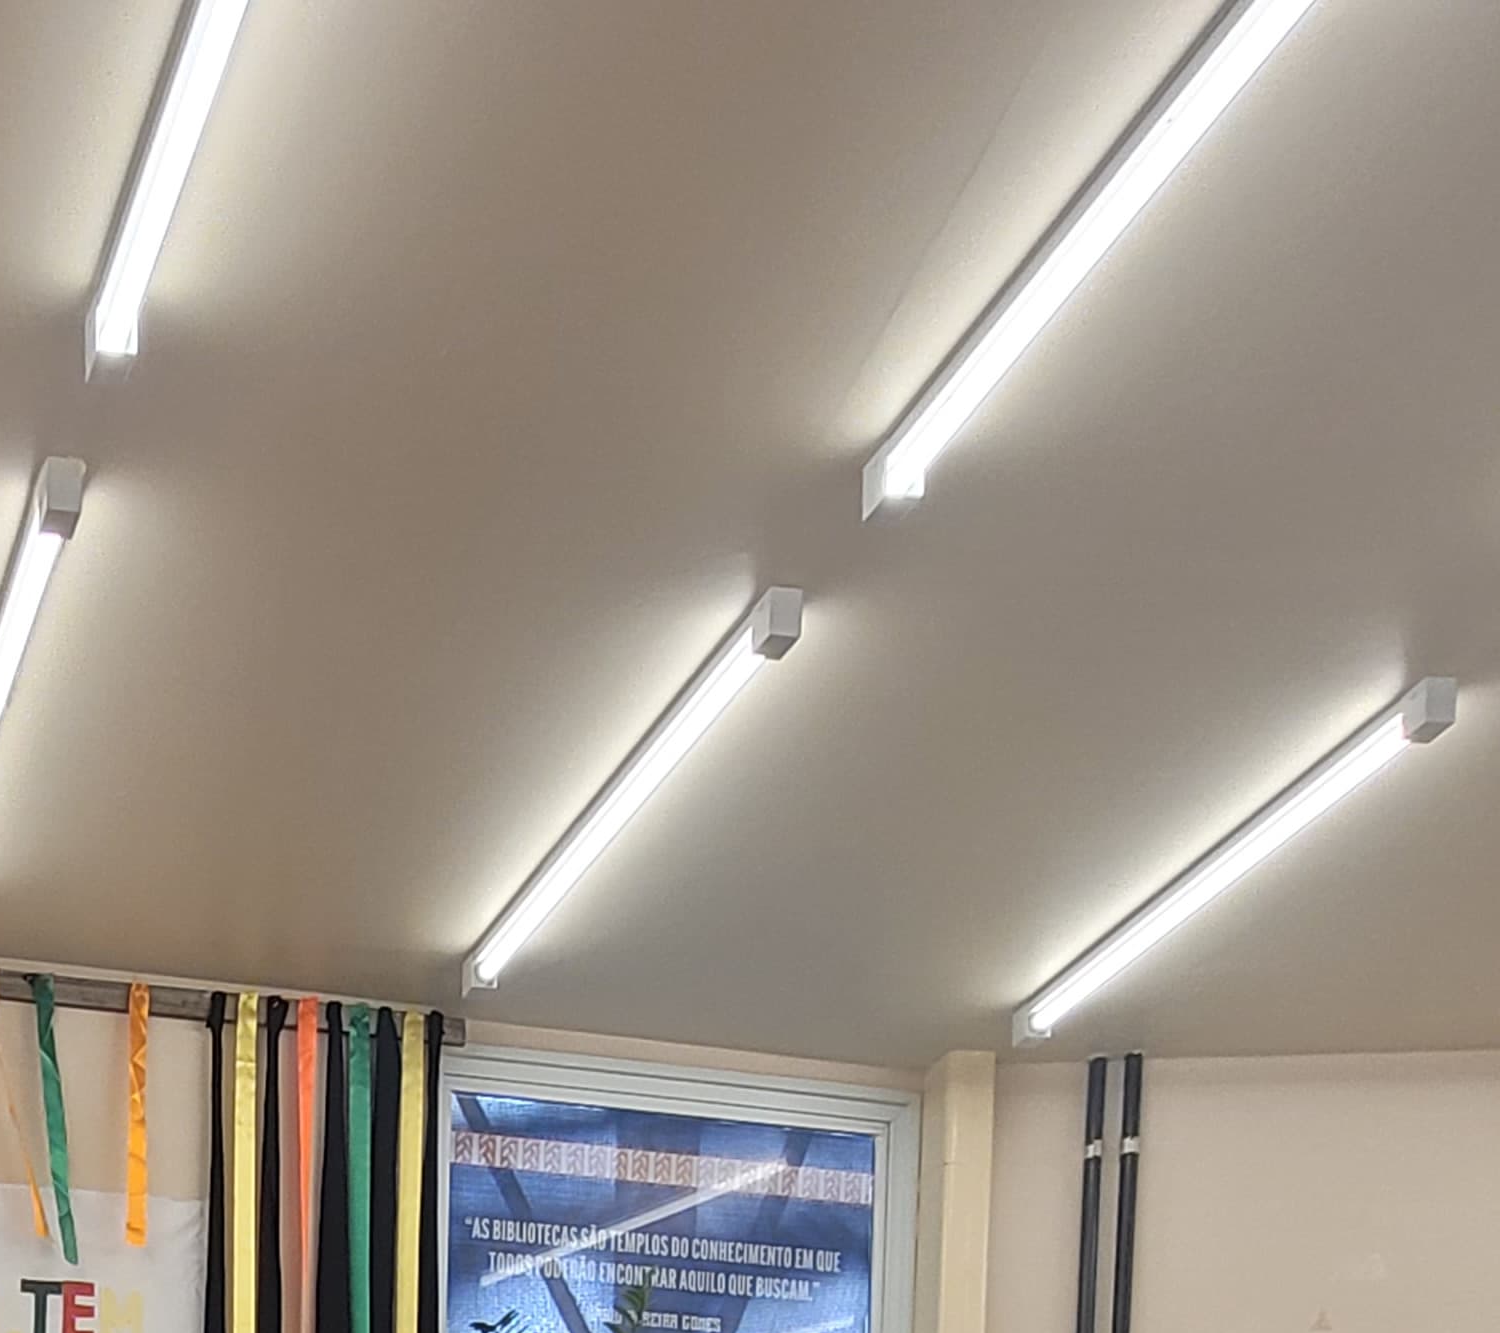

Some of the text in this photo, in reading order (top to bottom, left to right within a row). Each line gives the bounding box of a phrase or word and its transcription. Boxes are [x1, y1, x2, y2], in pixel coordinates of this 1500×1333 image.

[492, 1219, 578, 1248] BIBLIOTECAS
[580, 1224, 607, 1250] SÃO
[609, 1229, 669, 1256] TEMPLOS
[671, 1236, 689, 1259] DO
[691, 1238, 792, 1269] CONHECIMENTO
[794, 1247, 814, 1271] EM
[816, 1250, 841, 1273] QUE
[488, 1252, 535, 1277] TODOS
[534, 1256, 597, 1281] PODERÃO
[599, 1261, 677, 1290] ENCONTRAR
[679, 1269, 725, 1294] AQUILO
[728, 1273, 754, 1297] QUE
